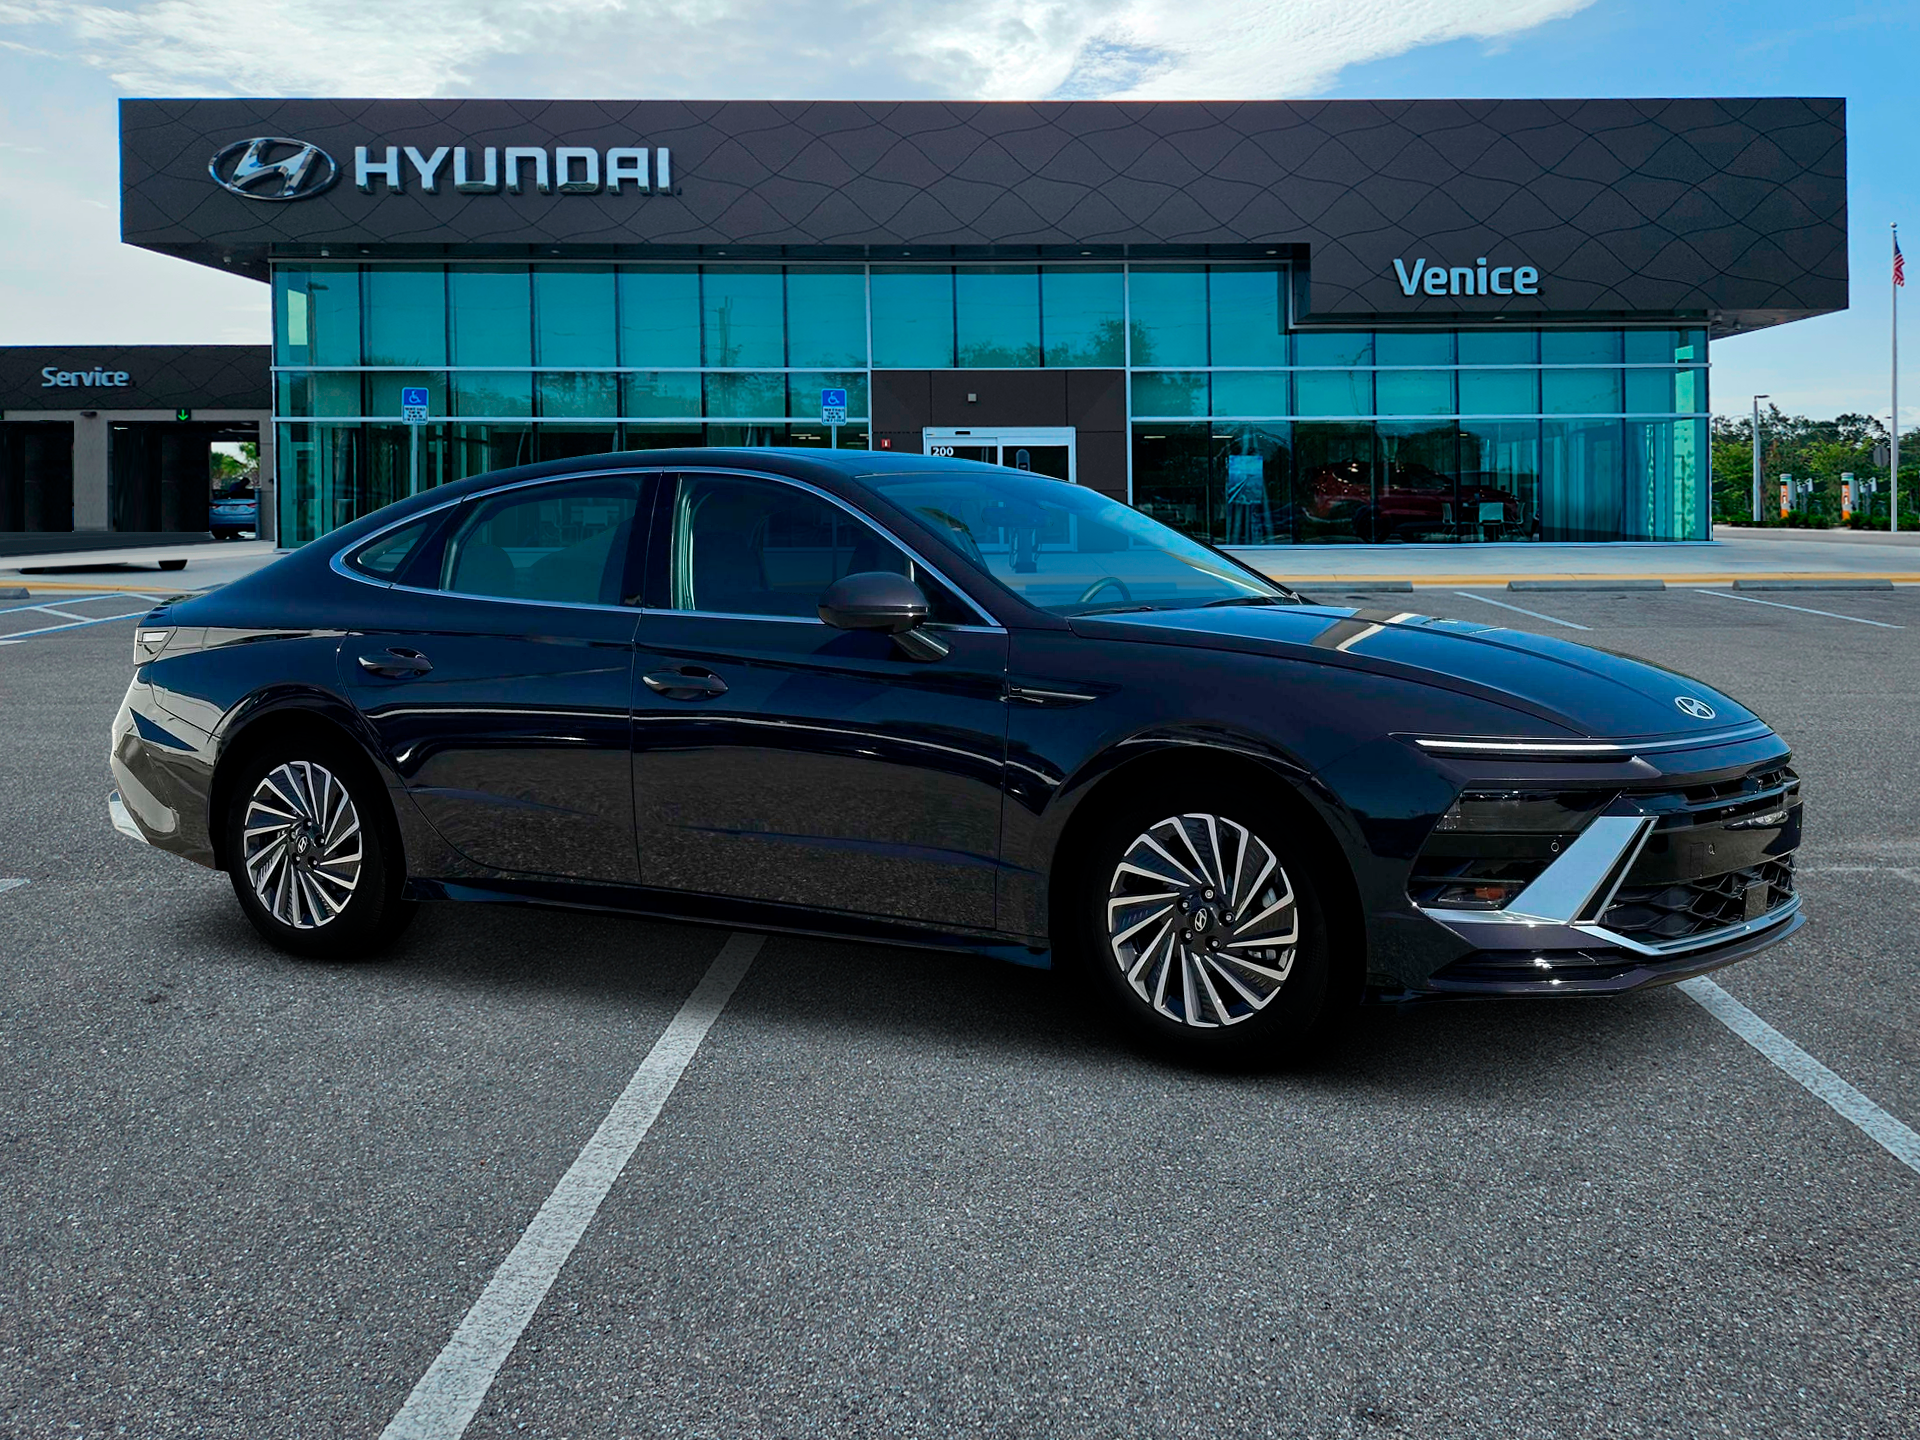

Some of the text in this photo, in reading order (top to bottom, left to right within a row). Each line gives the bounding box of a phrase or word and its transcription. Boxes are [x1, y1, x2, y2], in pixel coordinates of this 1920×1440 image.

[354, 146, 671, 193] HYUNDAI
[1393, 257, 1539, 296] Venice
[41, 366, 130, 387] Service
[932, 446, 955, 457] 200
